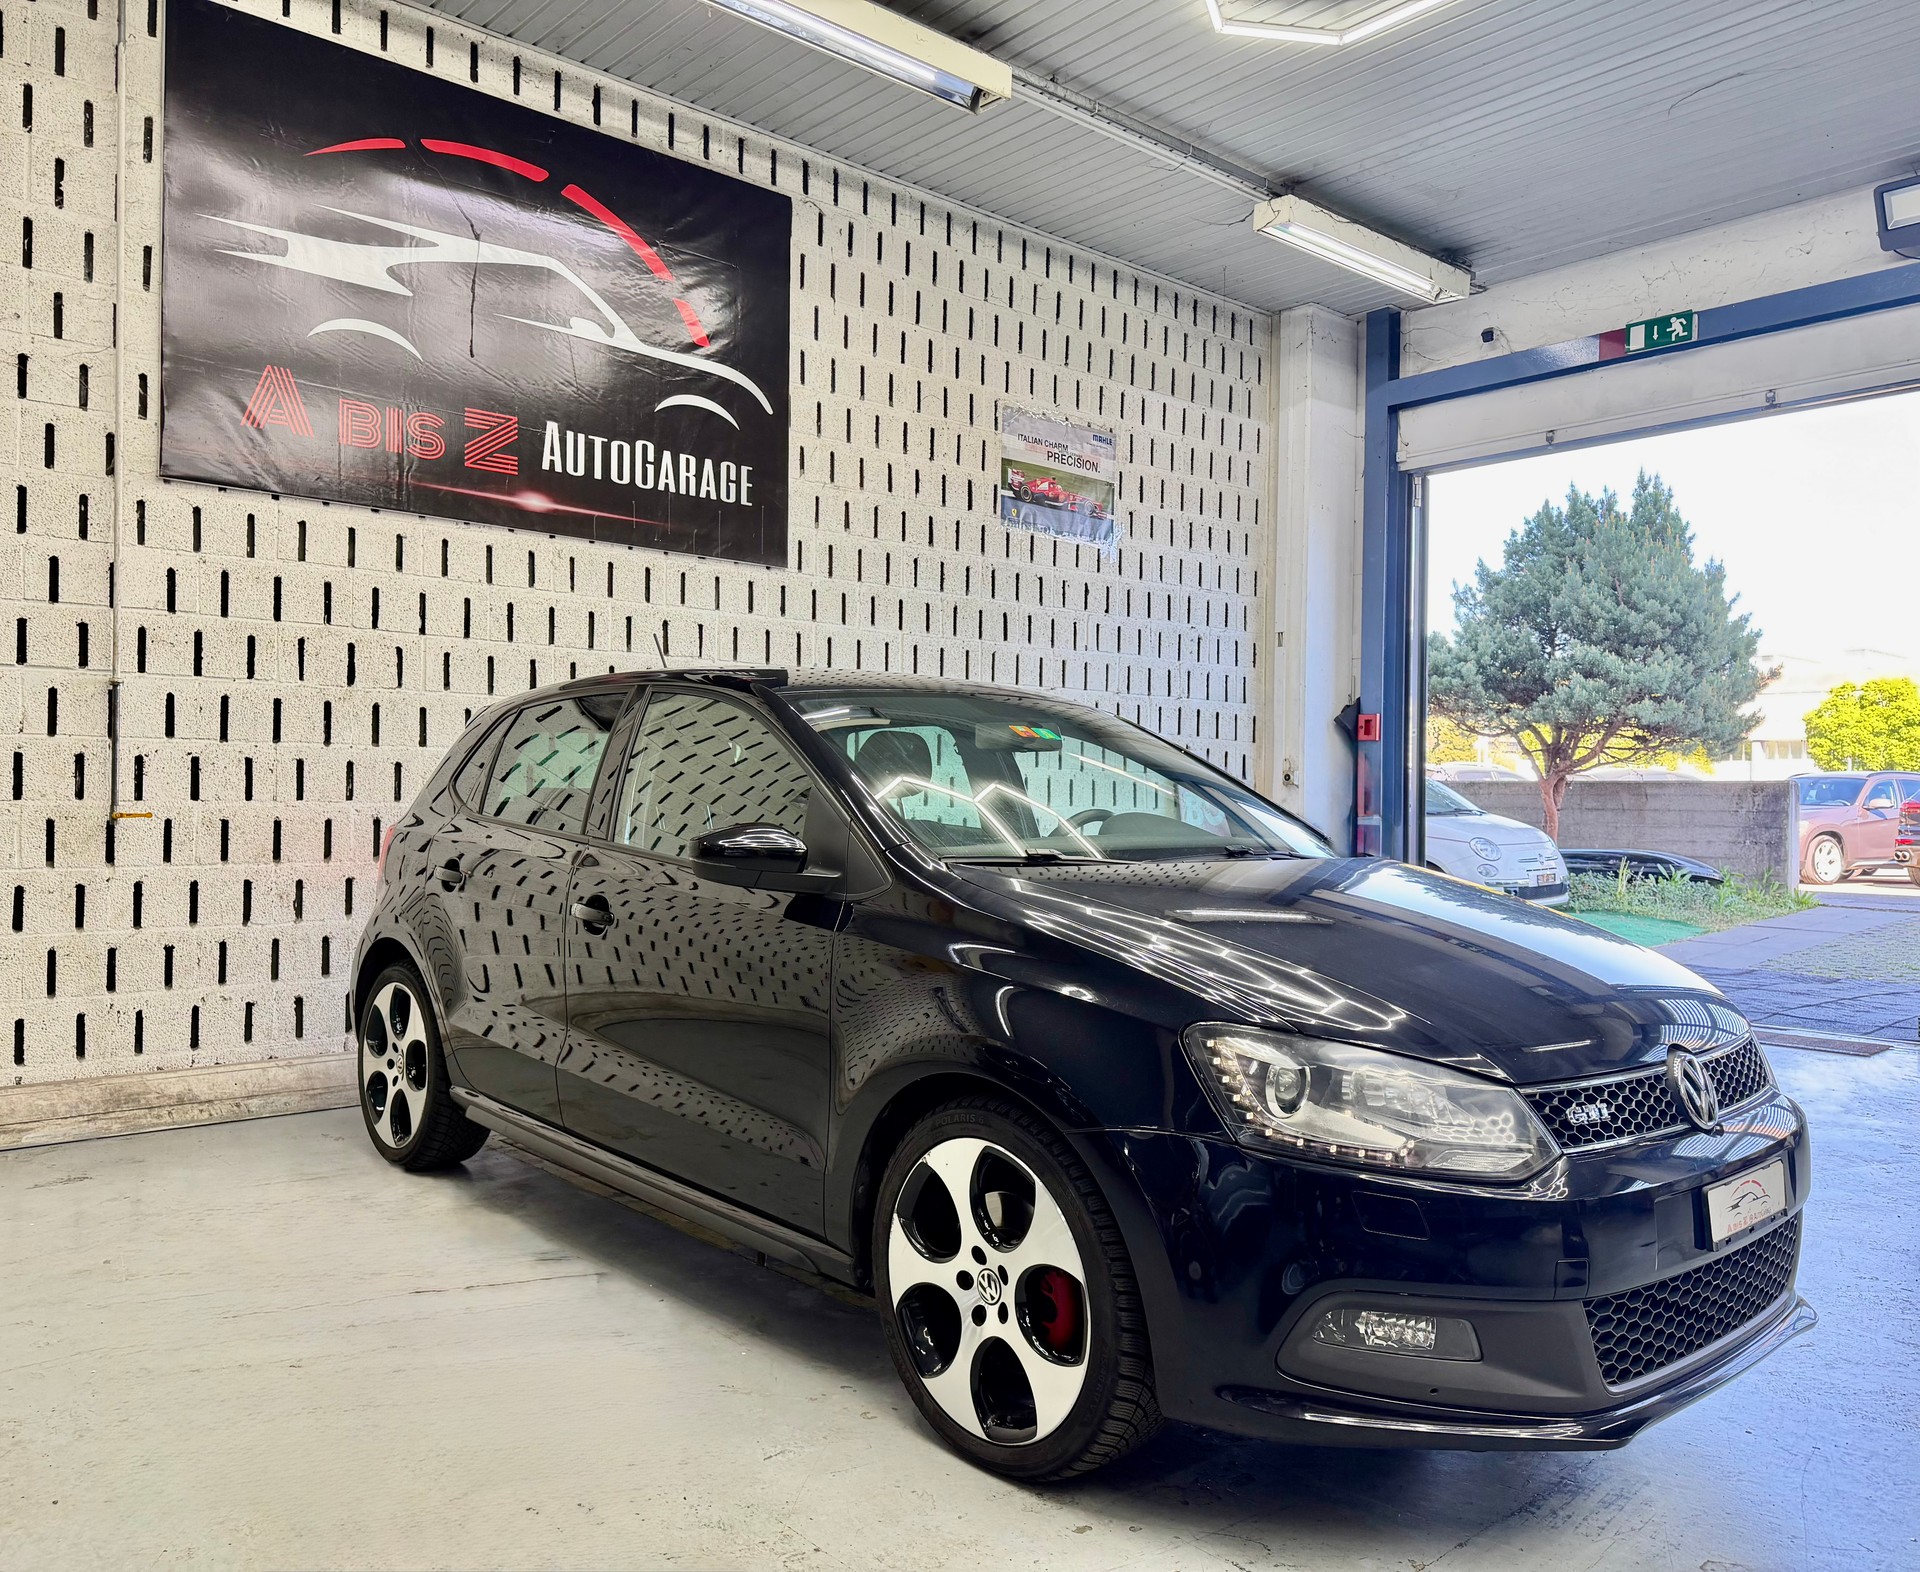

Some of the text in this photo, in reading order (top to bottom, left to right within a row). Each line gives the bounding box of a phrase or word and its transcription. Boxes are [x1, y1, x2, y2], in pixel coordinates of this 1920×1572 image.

[240, 364, 314, 438] A
[338, 398, 445, 460] BIS
[464, 407, 518, 476] Z
[1017, 433, 1069, 452] ITALIAN CHARM
[1092, 434, 1113, 446] MAHLE
[1047, 450, 1101, 474] PRECISION.
